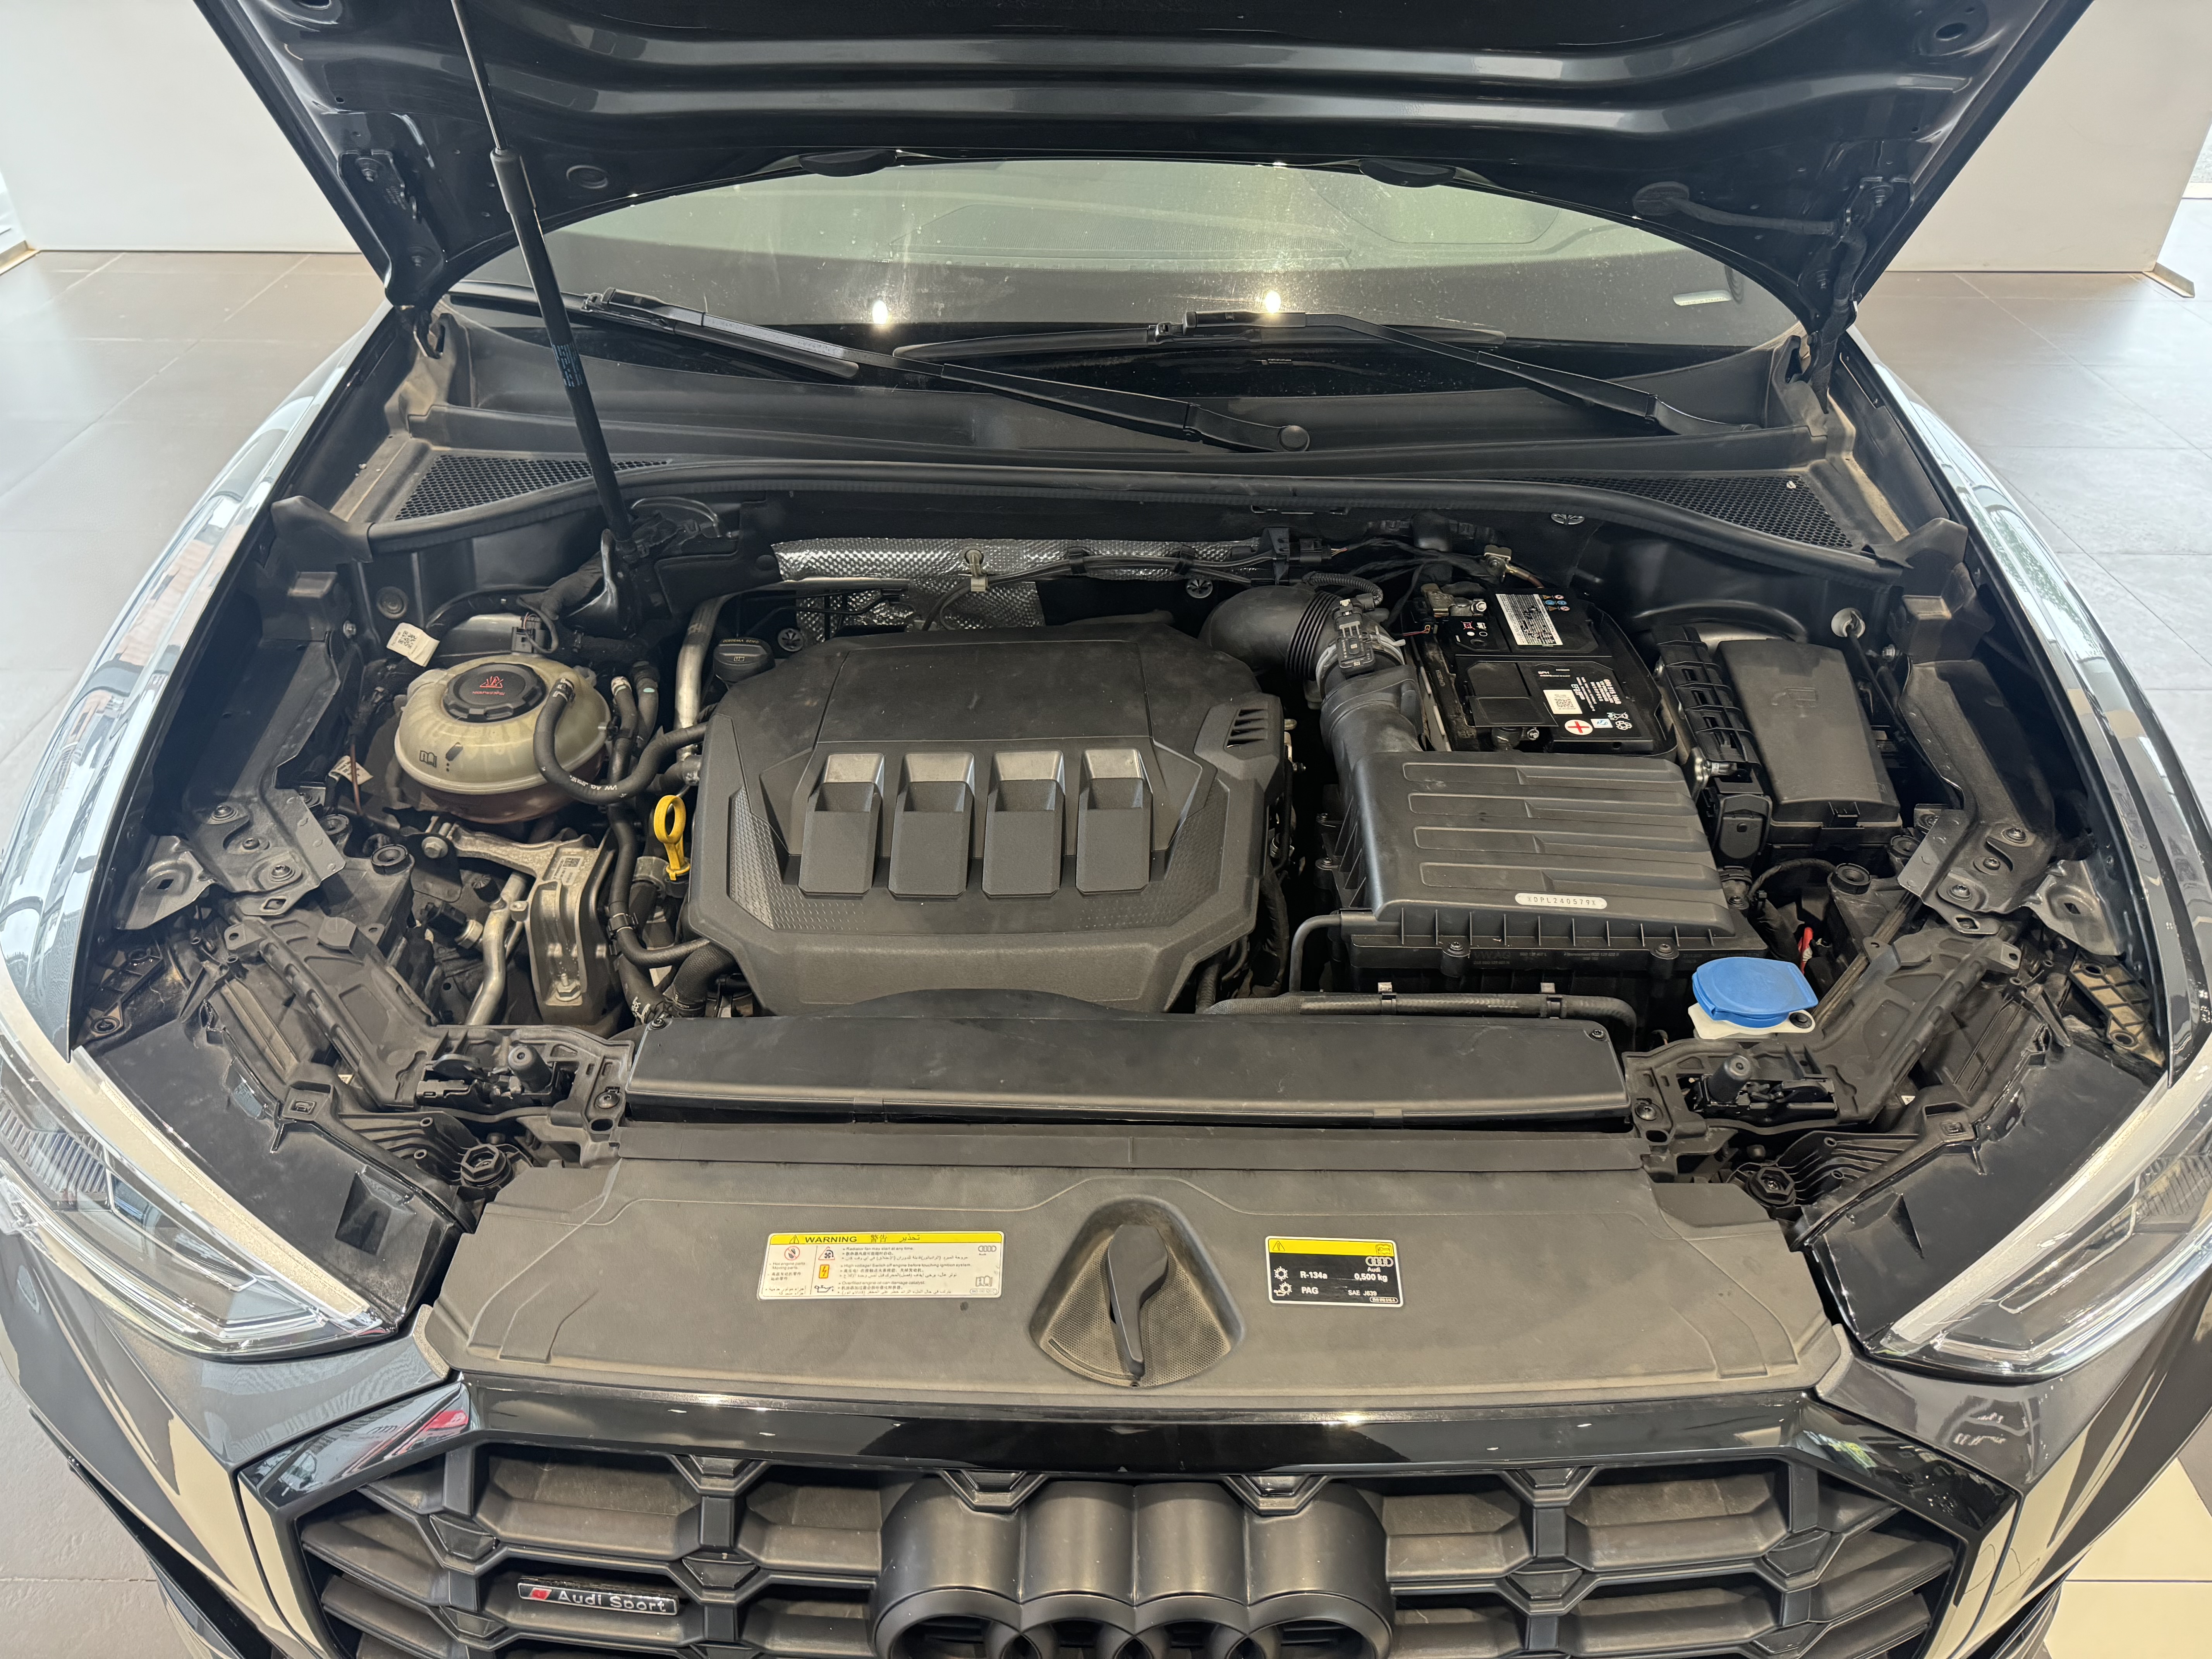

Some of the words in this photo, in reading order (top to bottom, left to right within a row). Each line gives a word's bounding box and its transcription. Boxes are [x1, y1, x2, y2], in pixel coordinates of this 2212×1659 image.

[899, 1233, 920, 1243] تحذير
[1300, 1271, 1328, 1279] R-134a
[1377, 1274, 1388, 1282] kg
[557, 1590, 602, 1606] Audi
[610, 1596, 666, 1613] Sport
